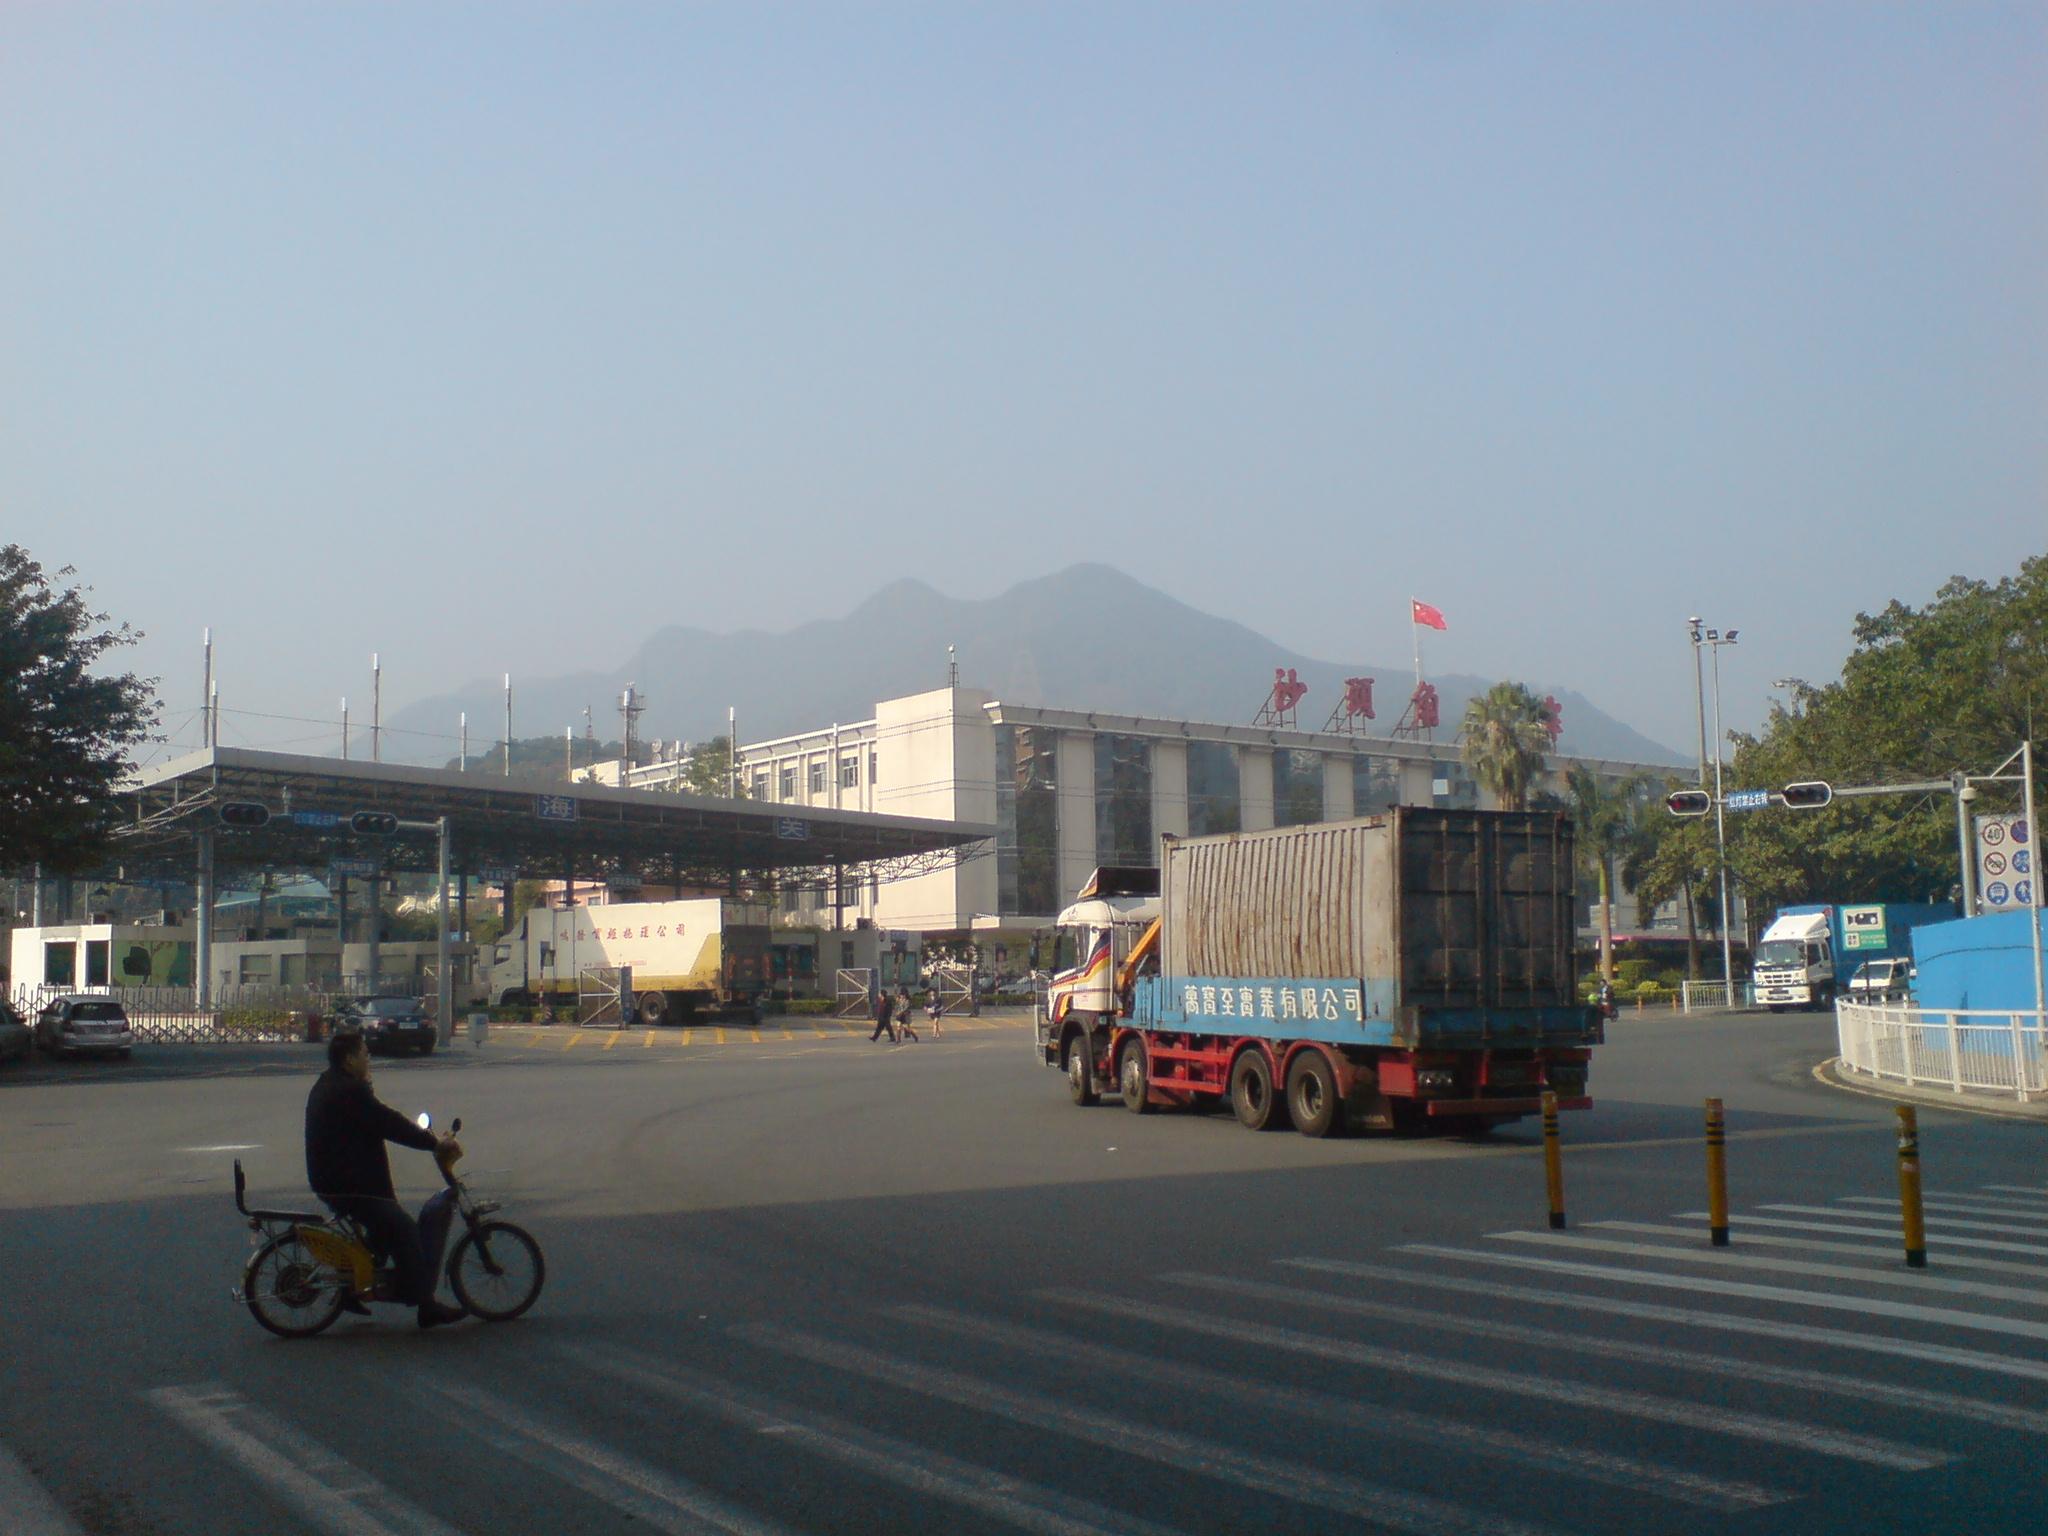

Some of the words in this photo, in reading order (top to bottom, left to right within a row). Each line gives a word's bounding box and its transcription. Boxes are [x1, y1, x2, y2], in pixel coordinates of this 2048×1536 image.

[543, 795, 573, 818] 海
[781, 816, 804, 838] 关
[1987, 827, 2001, 841] 40
[1184, 984, 1363, 1022] 萬寶至實業有限公司
